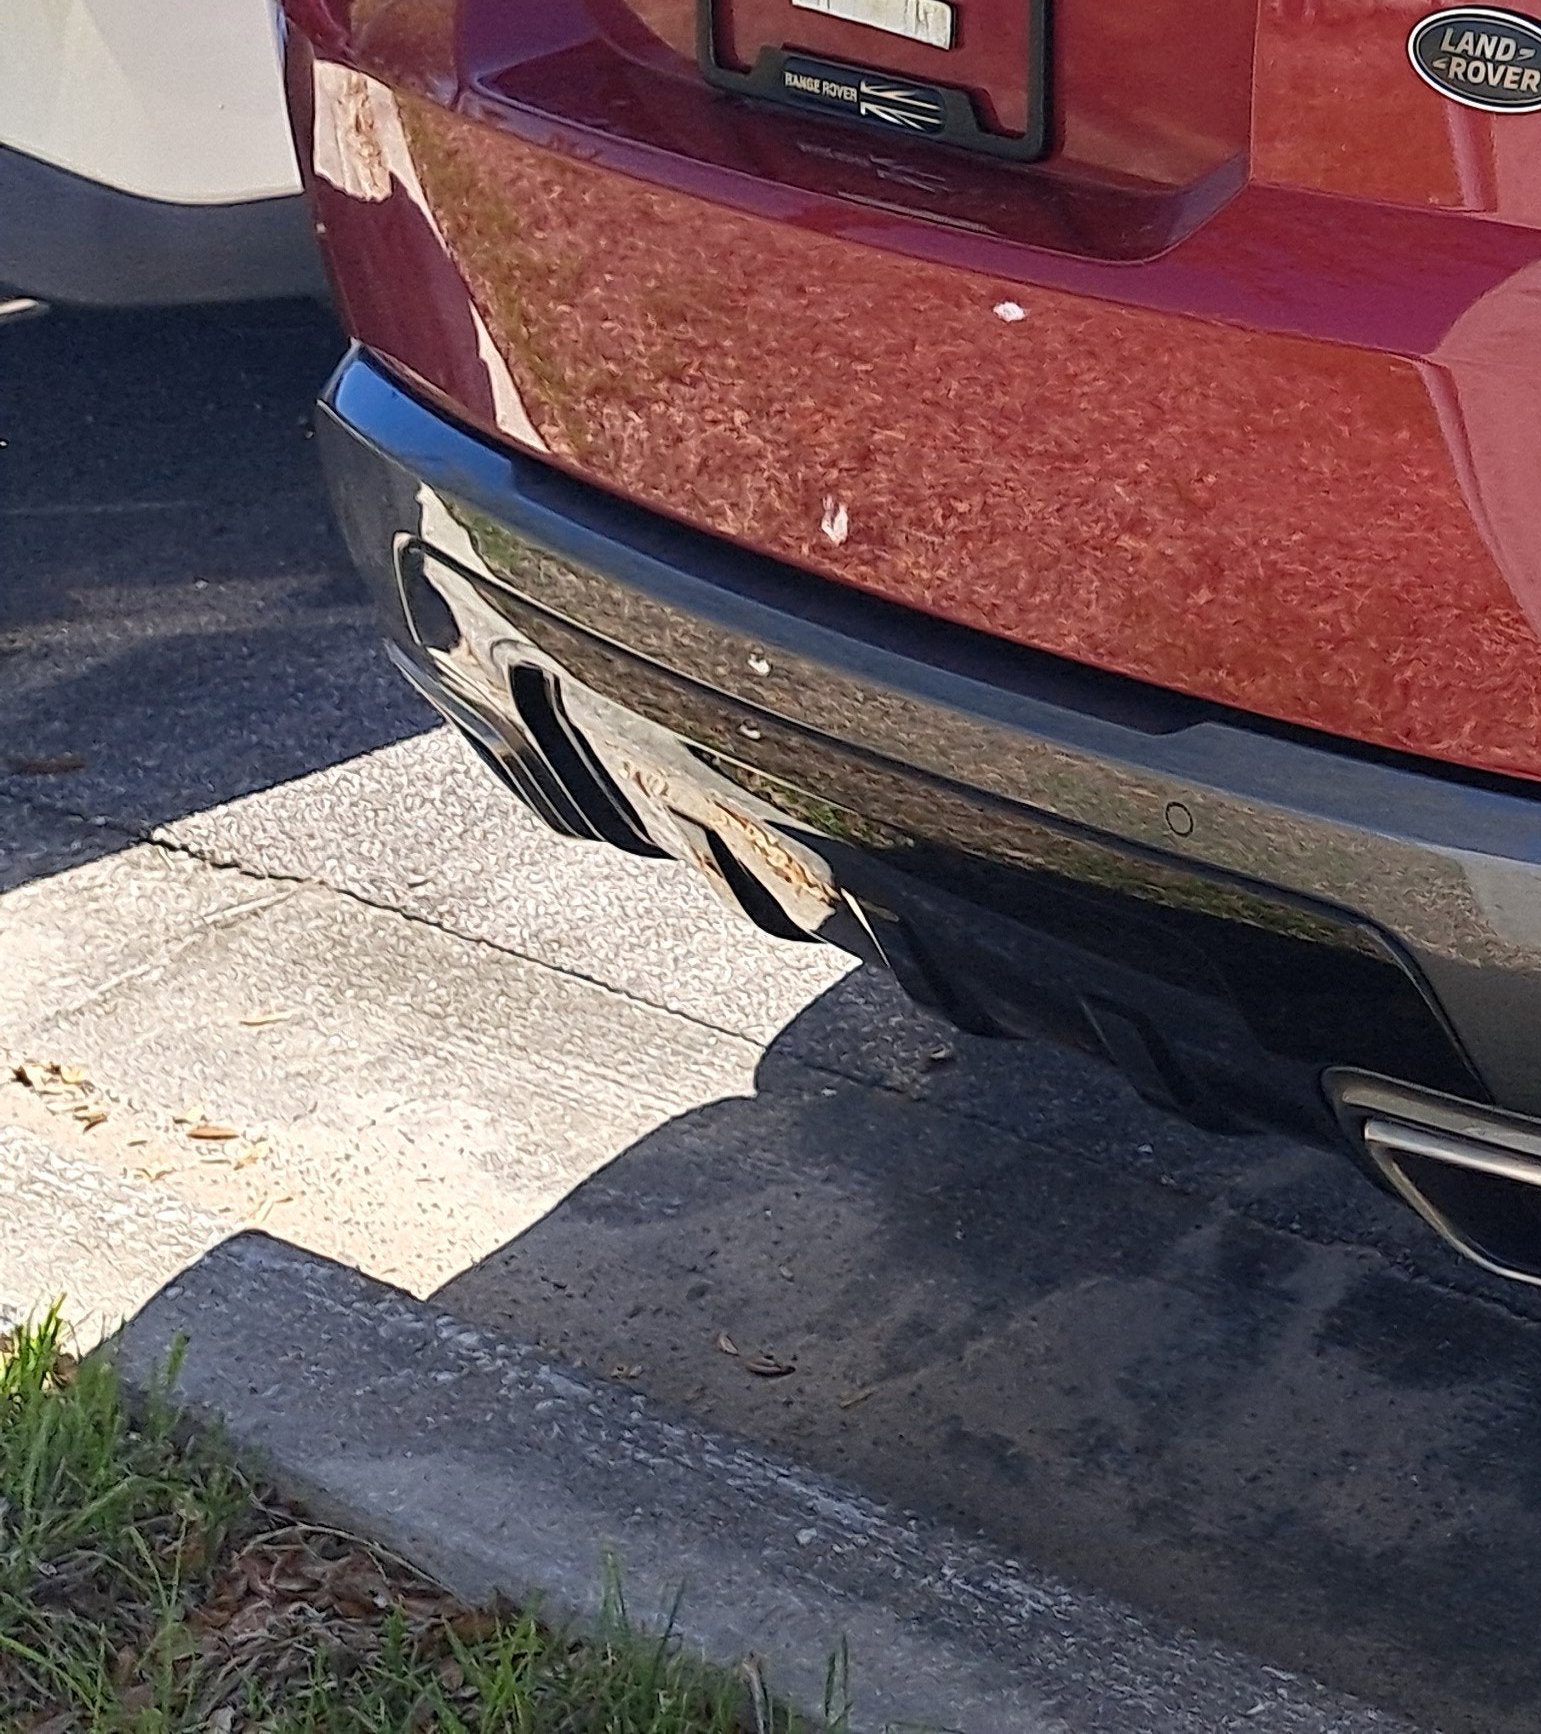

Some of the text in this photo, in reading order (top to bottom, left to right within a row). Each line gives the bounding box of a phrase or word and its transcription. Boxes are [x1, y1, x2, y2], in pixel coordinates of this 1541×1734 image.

[1441, 28, 1516, 61] LAND
[784, 71, 857, 102] RANGE ROVER
[1449, 57, 1541, 92] ROVER
